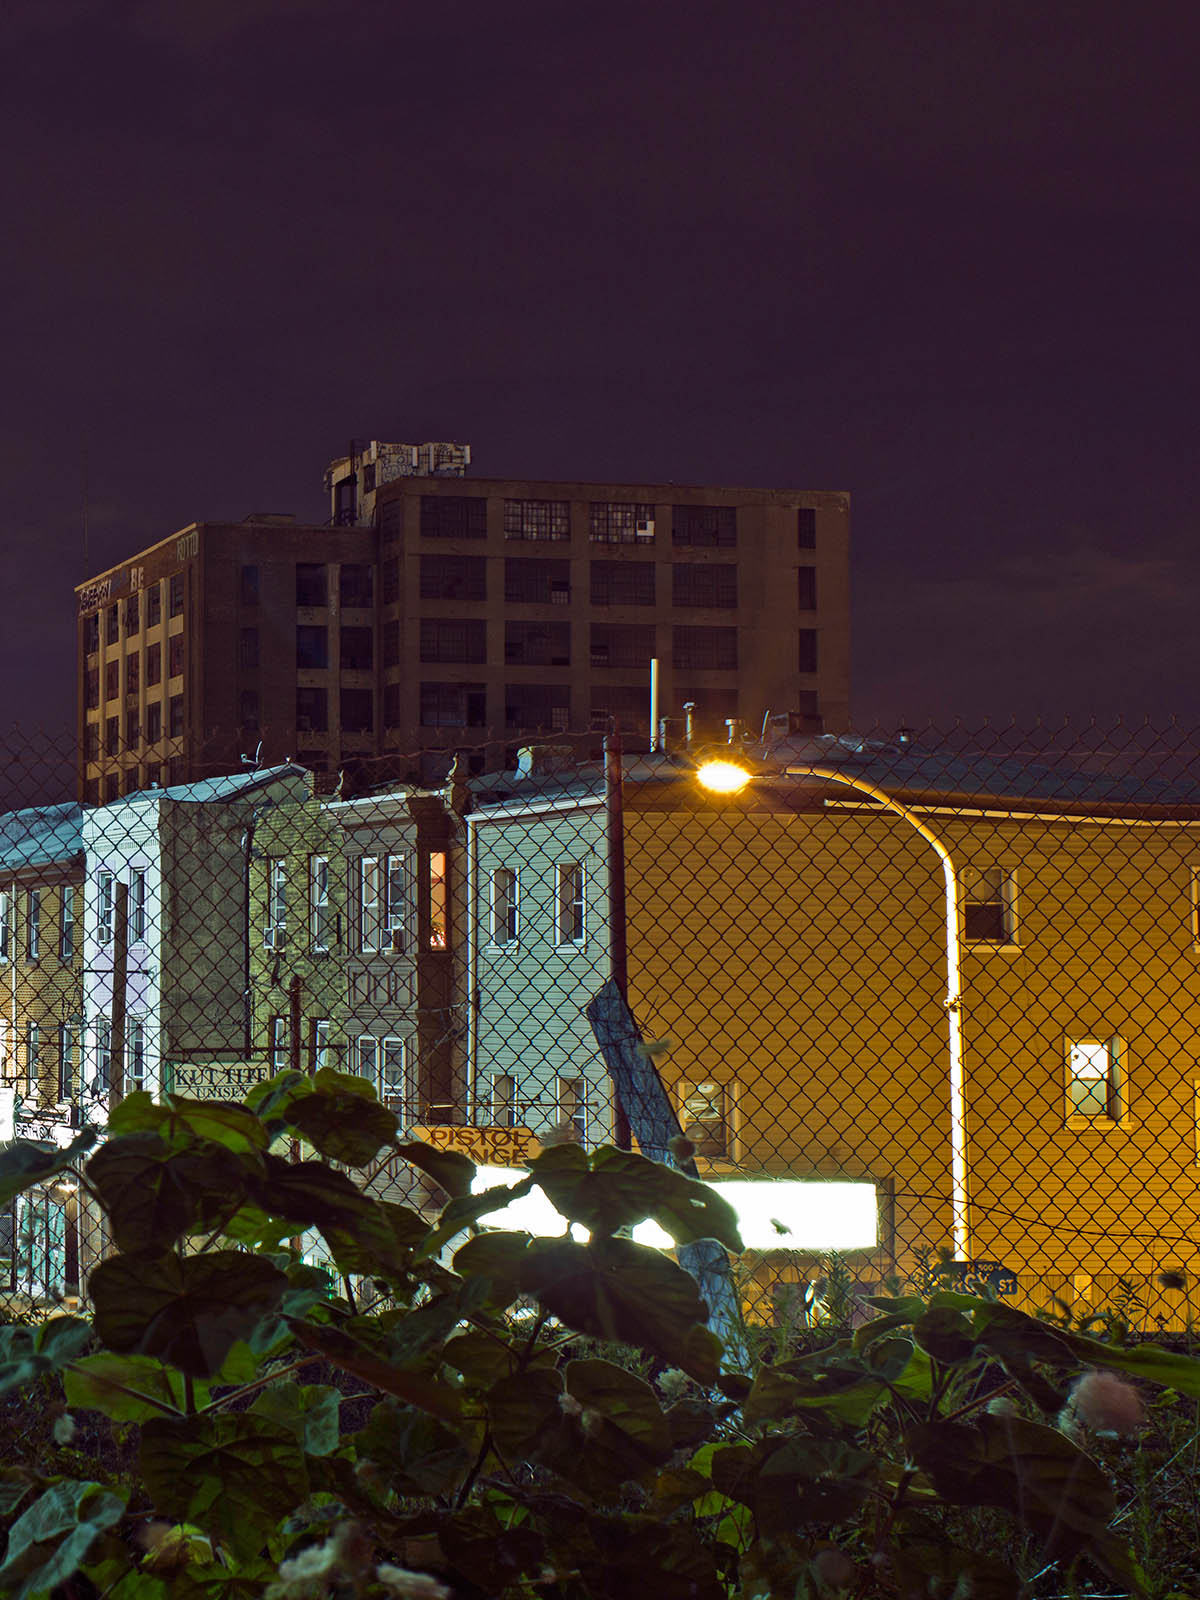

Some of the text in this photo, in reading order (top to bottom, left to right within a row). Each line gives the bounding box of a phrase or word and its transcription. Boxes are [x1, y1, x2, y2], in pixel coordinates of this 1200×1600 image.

[175, 1068, 268, 1085] KUT TITE
[195, 1086, 249, 1098] UNISEX
[430, 1129, 529, 1147] PISTOL
[998, 1279, 1014, 1292] ST
